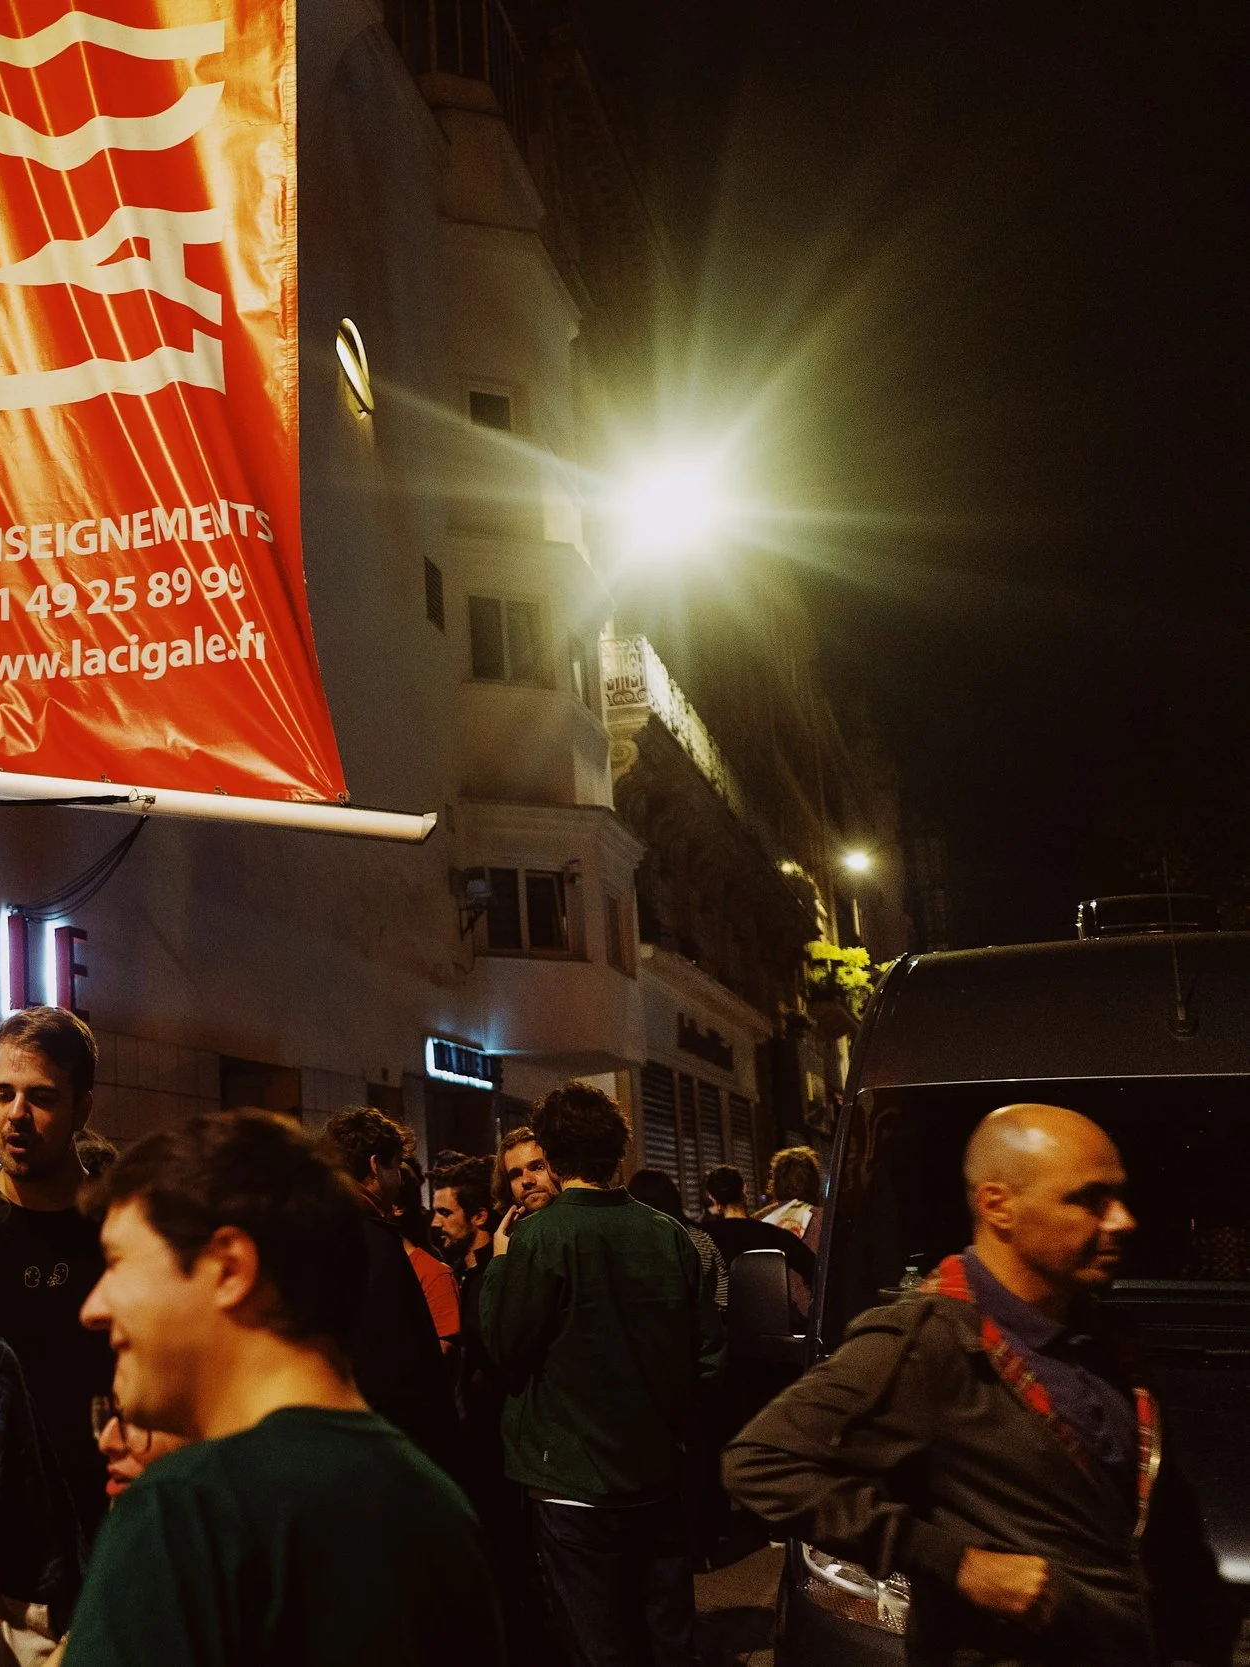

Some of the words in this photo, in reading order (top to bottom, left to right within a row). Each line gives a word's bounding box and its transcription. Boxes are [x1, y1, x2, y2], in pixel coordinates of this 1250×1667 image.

[25, 582, 77, 619] 49
[86, 576, 136, 614] 25
[147, 567, 192, 607] 89
[201, 563, 246, 601] 99
